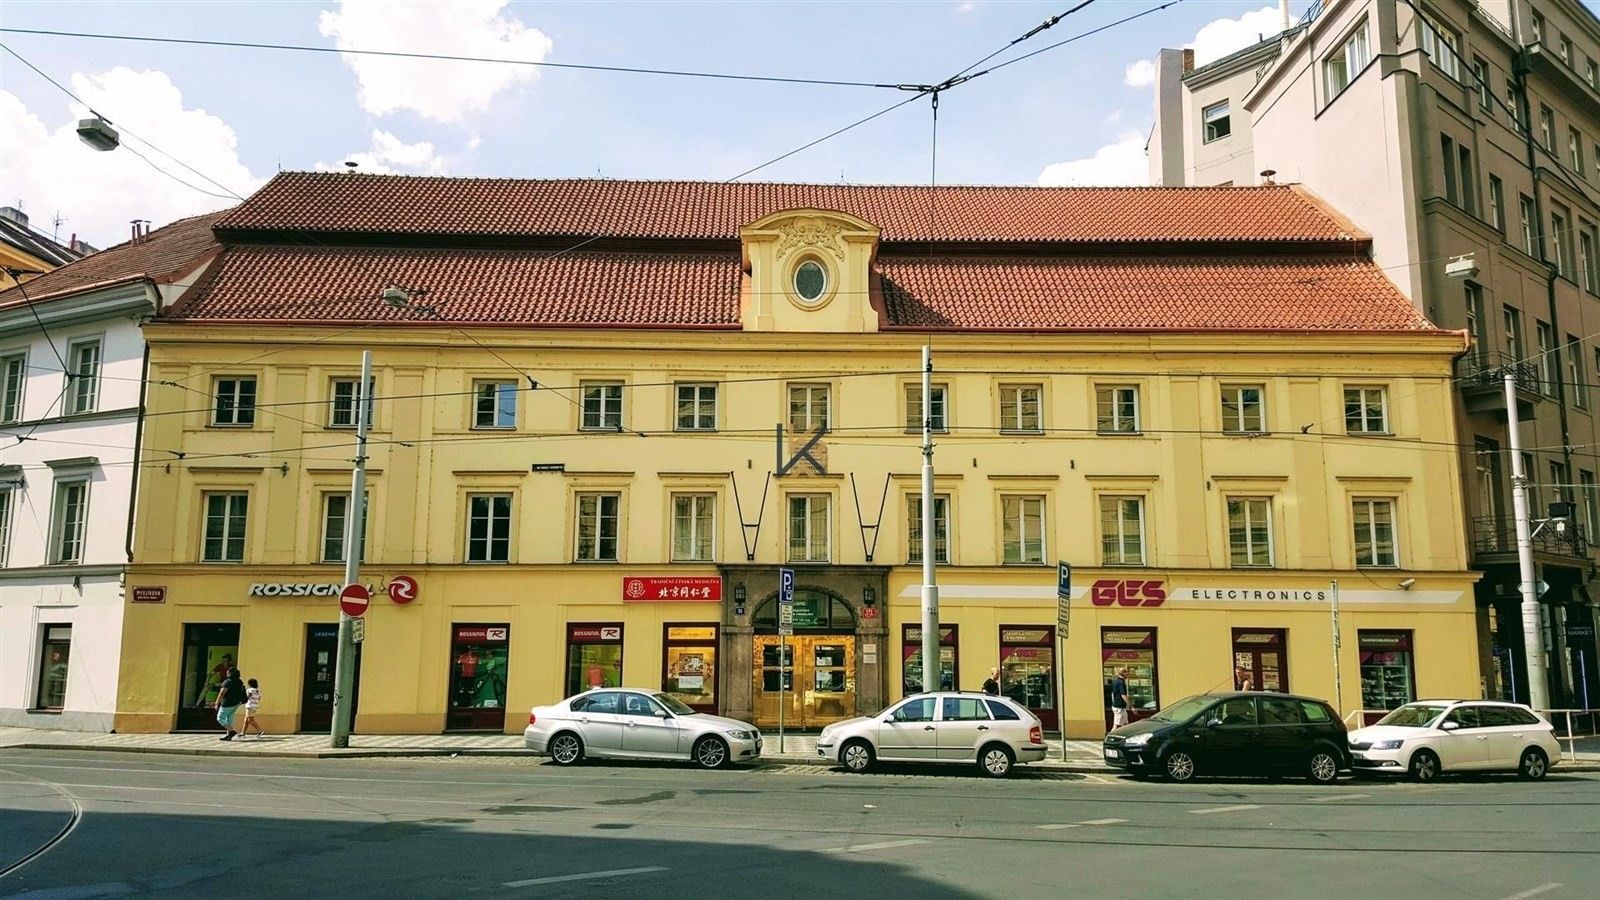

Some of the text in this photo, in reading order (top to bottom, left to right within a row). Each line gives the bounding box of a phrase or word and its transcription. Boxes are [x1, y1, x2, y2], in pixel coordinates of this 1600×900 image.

[783, 573, 792, 592] P
[1061, 566, 1069, 585] P
[248, 582, 375, 597] ROSSIGNL
[658, 586, 711, 598] 北京同仁堂
[1092, 579, 1166, 607] GES
[1192, 589, 1326, 601] ELECTRONICS
